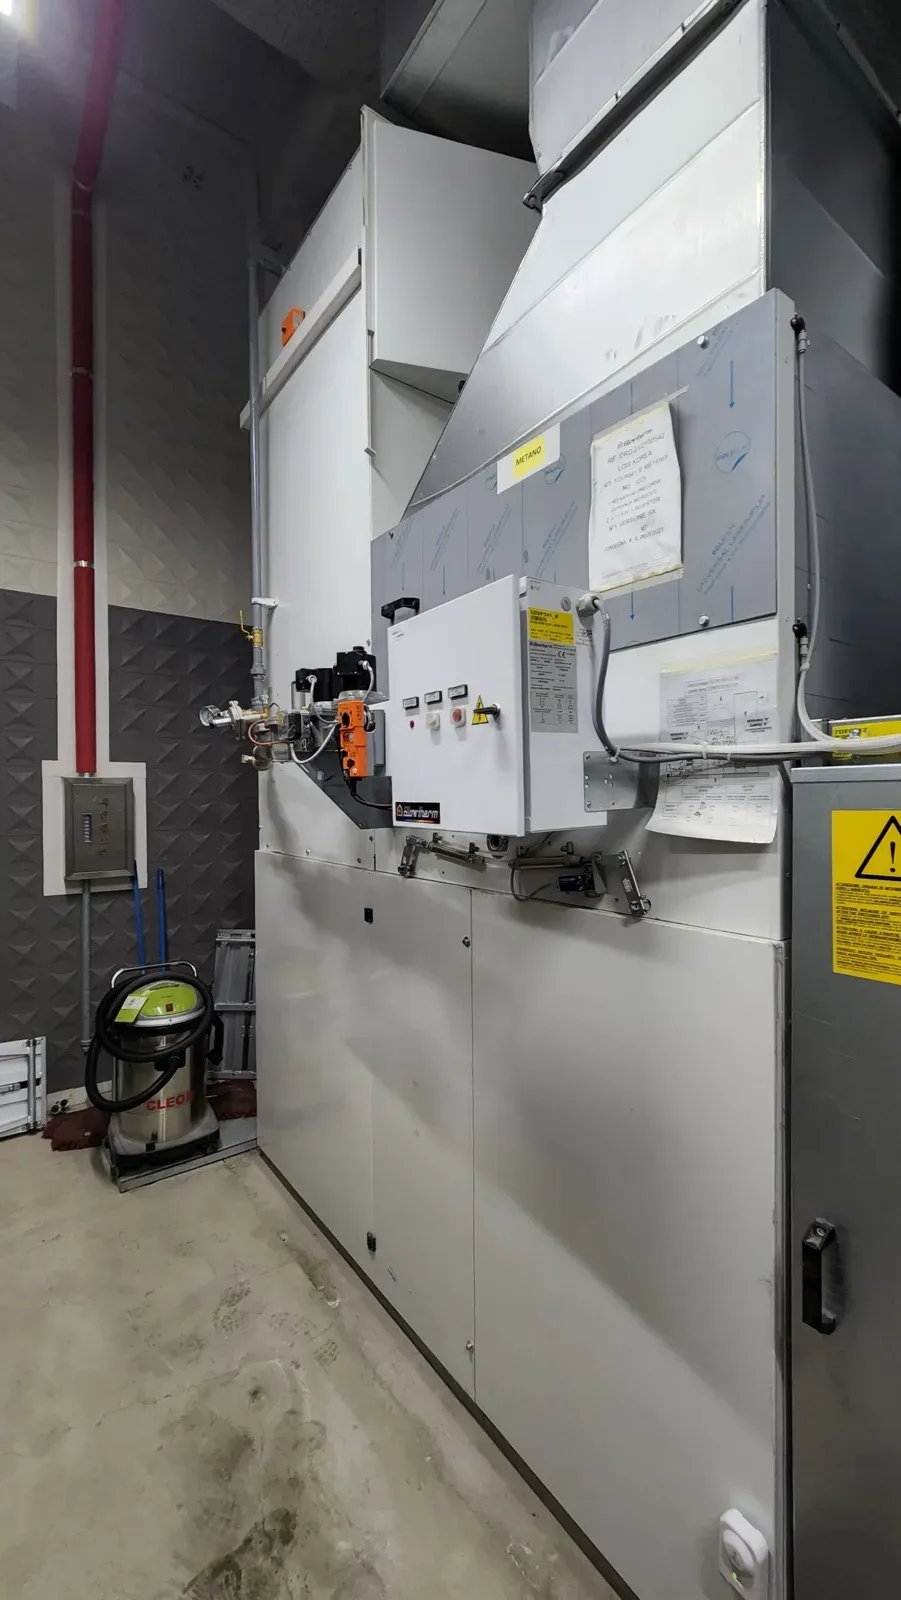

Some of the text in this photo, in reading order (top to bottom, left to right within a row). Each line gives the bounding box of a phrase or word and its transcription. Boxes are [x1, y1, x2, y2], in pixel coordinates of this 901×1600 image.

[516, 446, 542, 466] METANO
[620, 512, 646, 527] VERSIONE
[404, 806, 438, 818] Blowtherm
